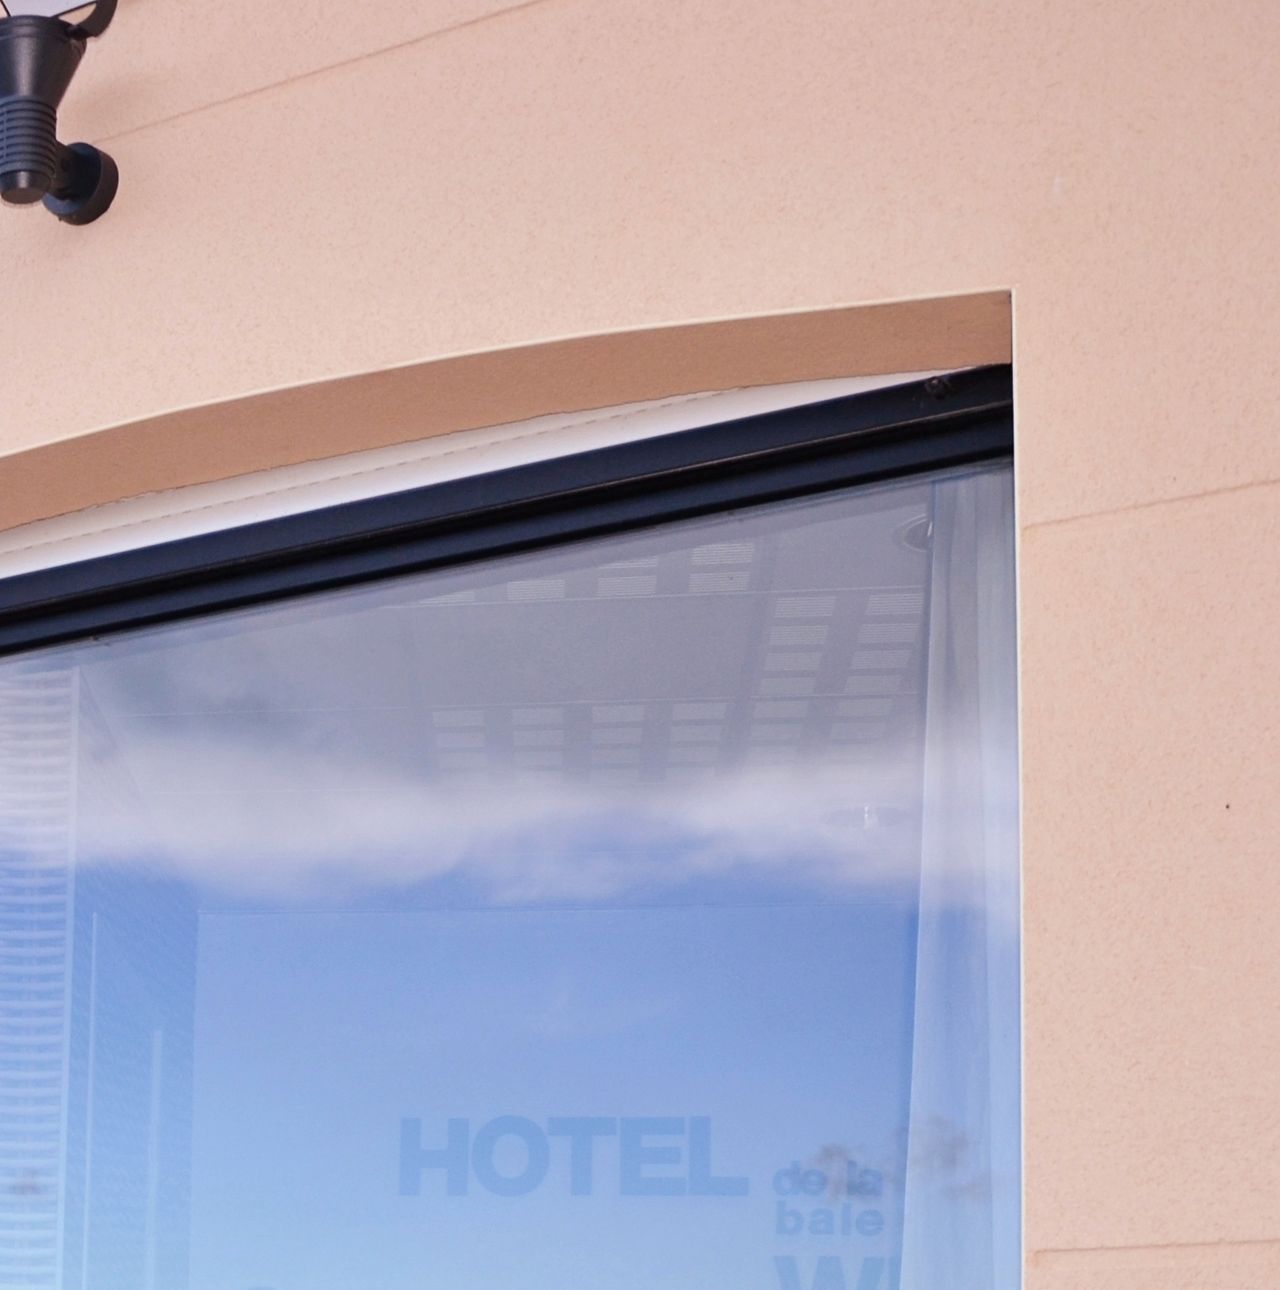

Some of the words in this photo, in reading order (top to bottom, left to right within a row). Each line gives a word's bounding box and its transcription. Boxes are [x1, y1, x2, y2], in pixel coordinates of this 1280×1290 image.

[398, 1114, 750, 1197] HOTEL
[772, 1160, 828, 1196] de
[846, 1160, 884, 1196] la
